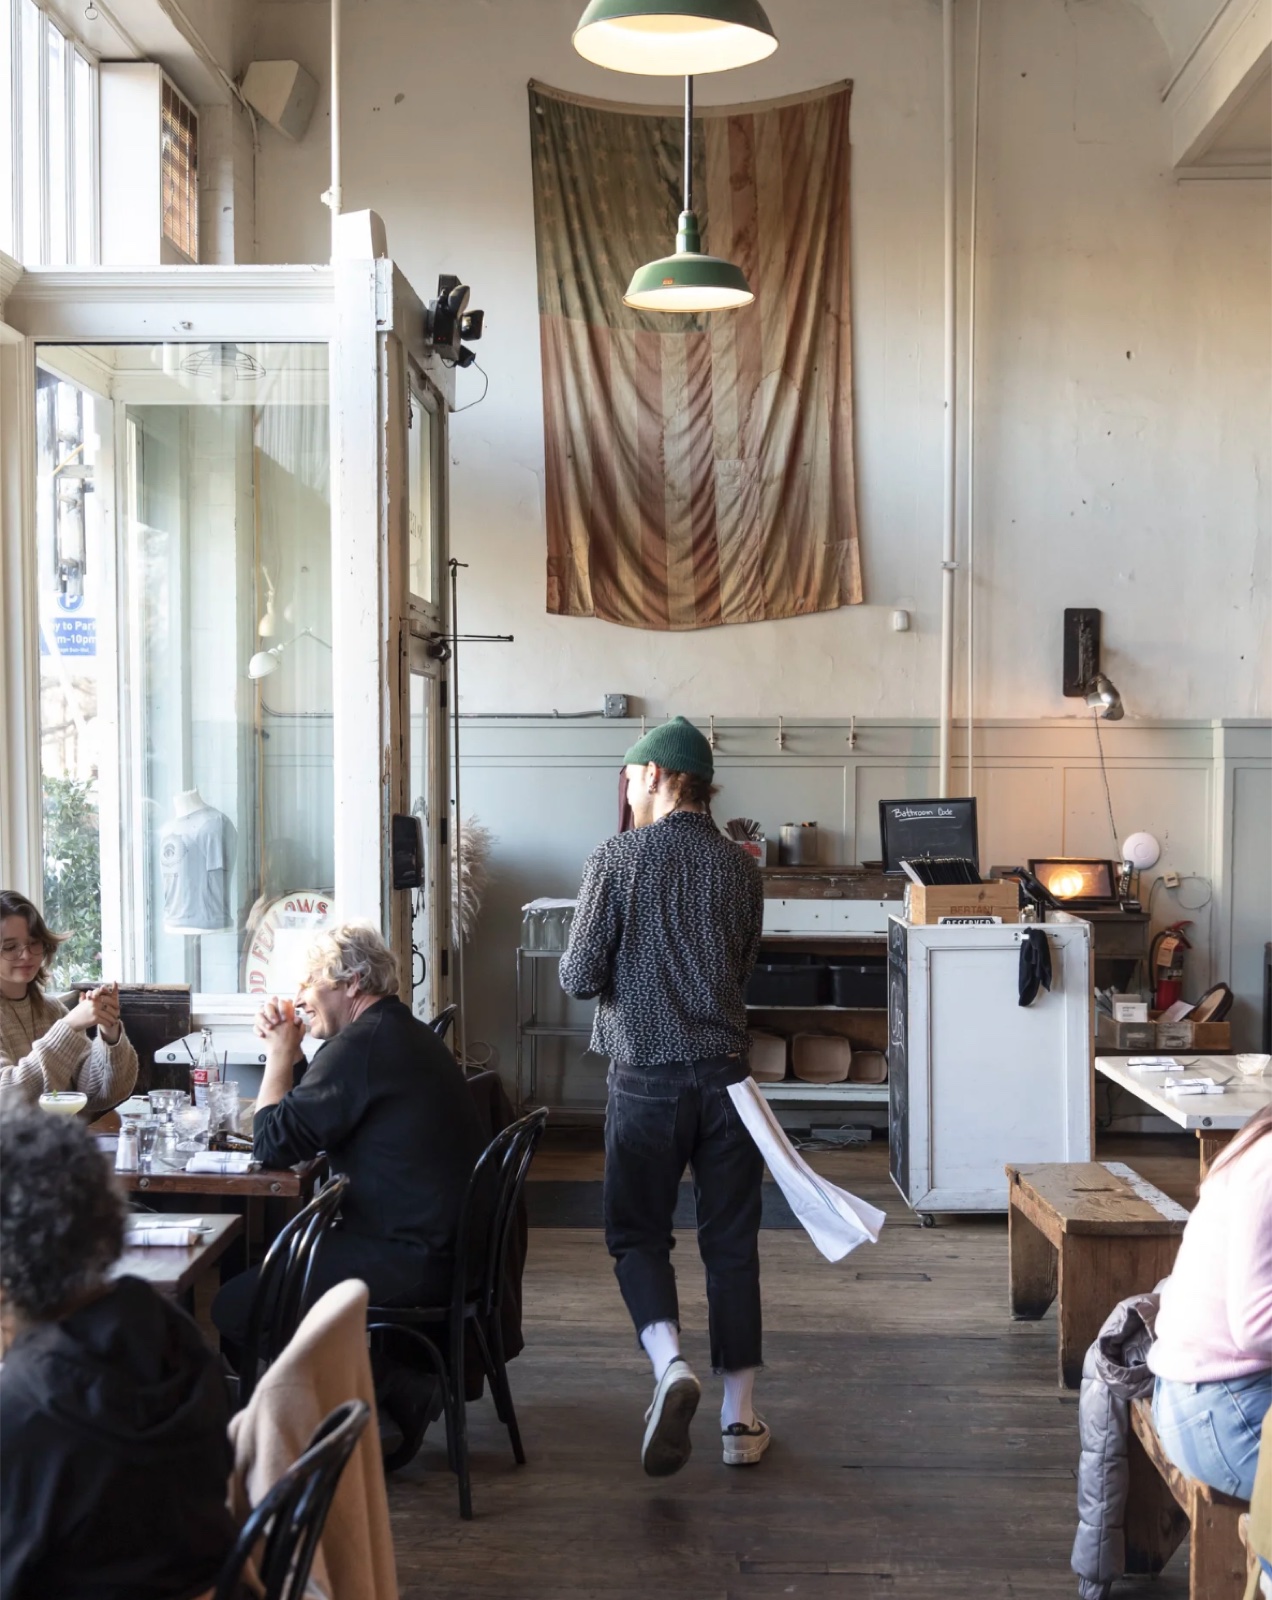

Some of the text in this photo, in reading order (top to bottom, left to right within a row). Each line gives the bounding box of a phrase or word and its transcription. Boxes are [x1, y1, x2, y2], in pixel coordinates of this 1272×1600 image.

[62, 622, 73, 631] to
[891, 807, 953, 818] Bathroom Code
[950, 905, 994, 916] BERTANI
